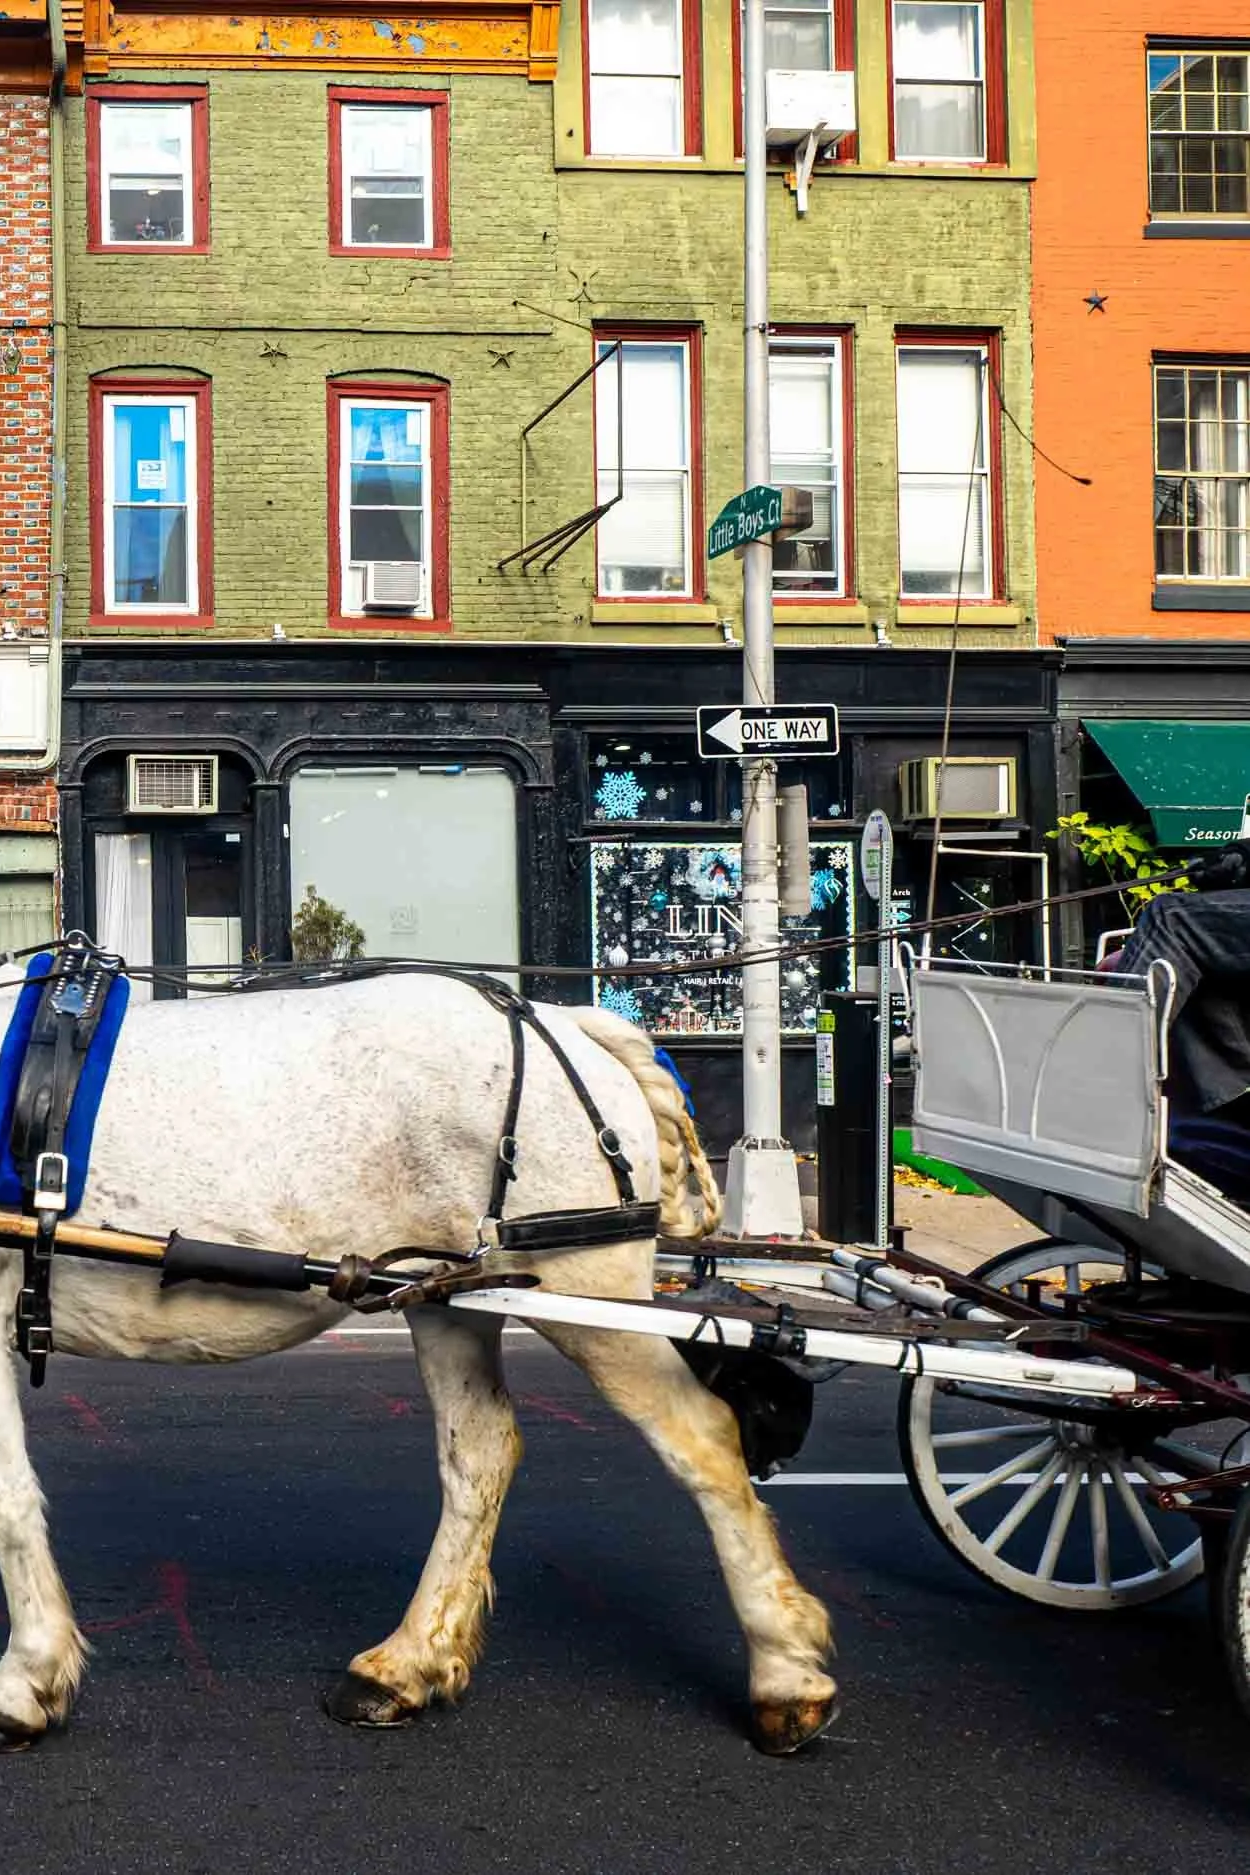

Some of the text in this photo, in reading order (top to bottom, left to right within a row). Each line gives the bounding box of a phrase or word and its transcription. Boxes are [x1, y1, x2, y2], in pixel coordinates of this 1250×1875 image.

[709, 498, 780, 554] Little Boys Ct
[741, 721, 821, 740] ONE WAY
